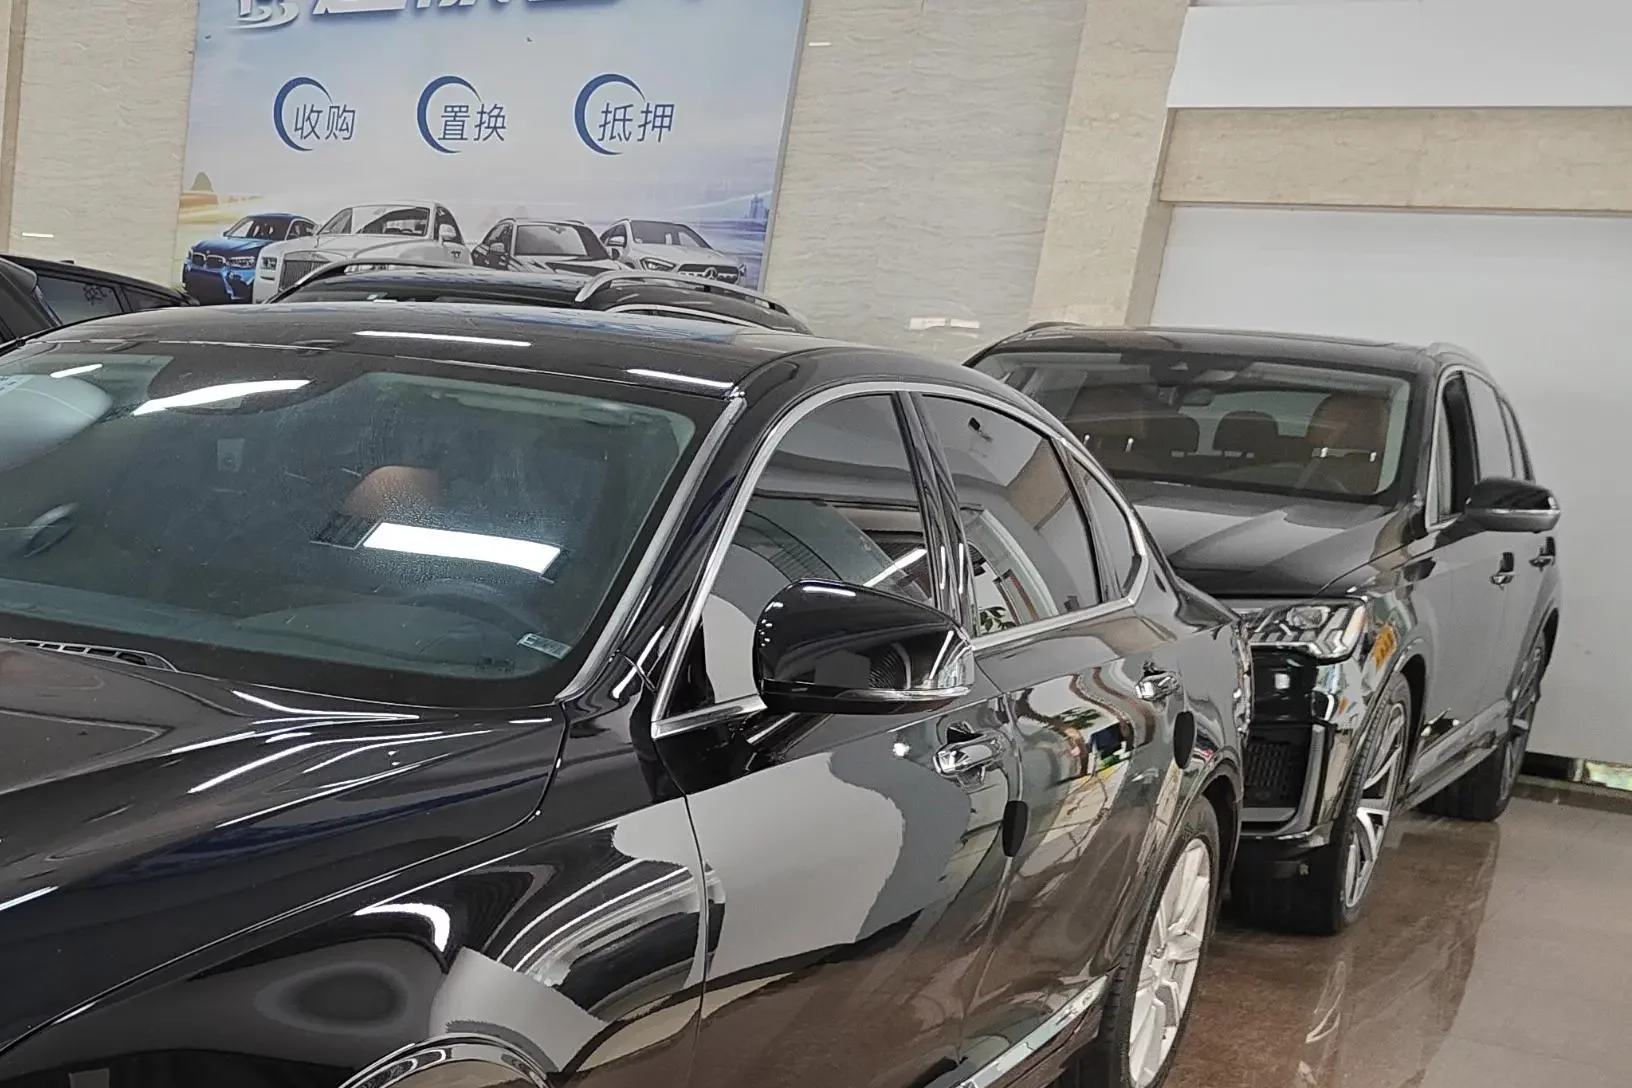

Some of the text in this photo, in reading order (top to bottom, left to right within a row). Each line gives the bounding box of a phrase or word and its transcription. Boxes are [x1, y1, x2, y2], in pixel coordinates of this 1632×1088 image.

[294, 102, 675, 143] 收购 置换 抵押
